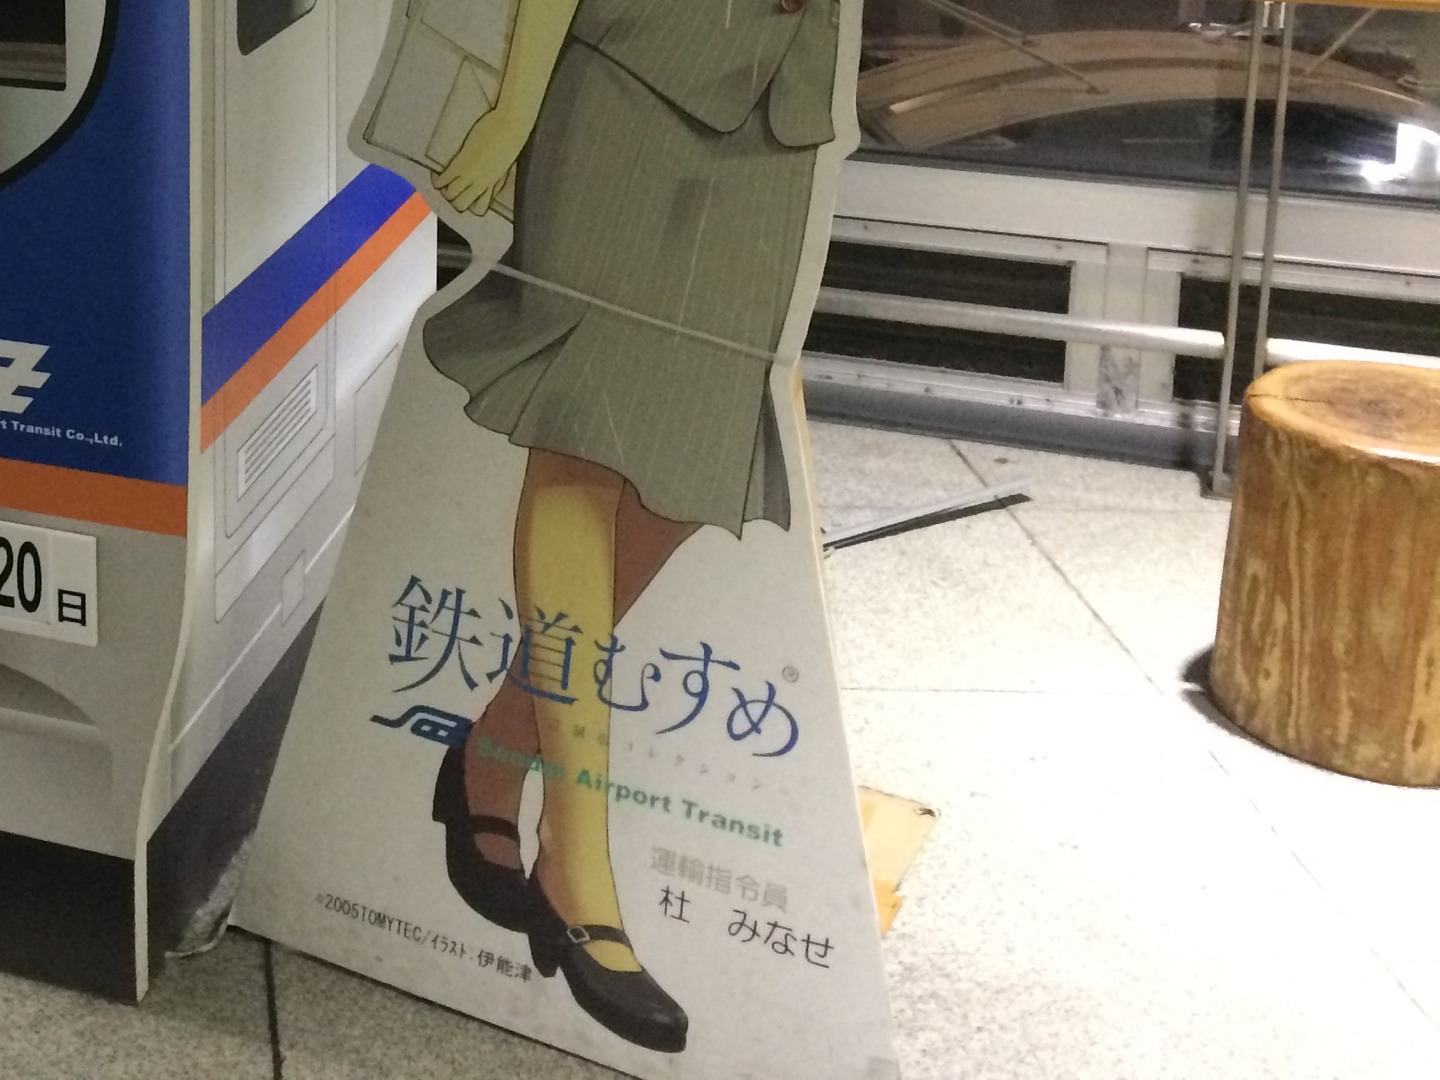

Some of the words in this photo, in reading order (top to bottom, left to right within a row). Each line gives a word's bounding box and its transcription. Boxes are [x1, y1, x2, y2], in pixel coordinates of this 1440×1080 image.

[11, 420, 62, 438] Transit
[389, 574, 799, 758] 鉄道むすめ
[576, 769, 672, 813] Airport
[682, 799, 784, 848] Transit
[650, 846, 788, 913] 運輸指令員
[659, 885, 691, 923] 杜
[728, 909, 834, 969] みなせ
